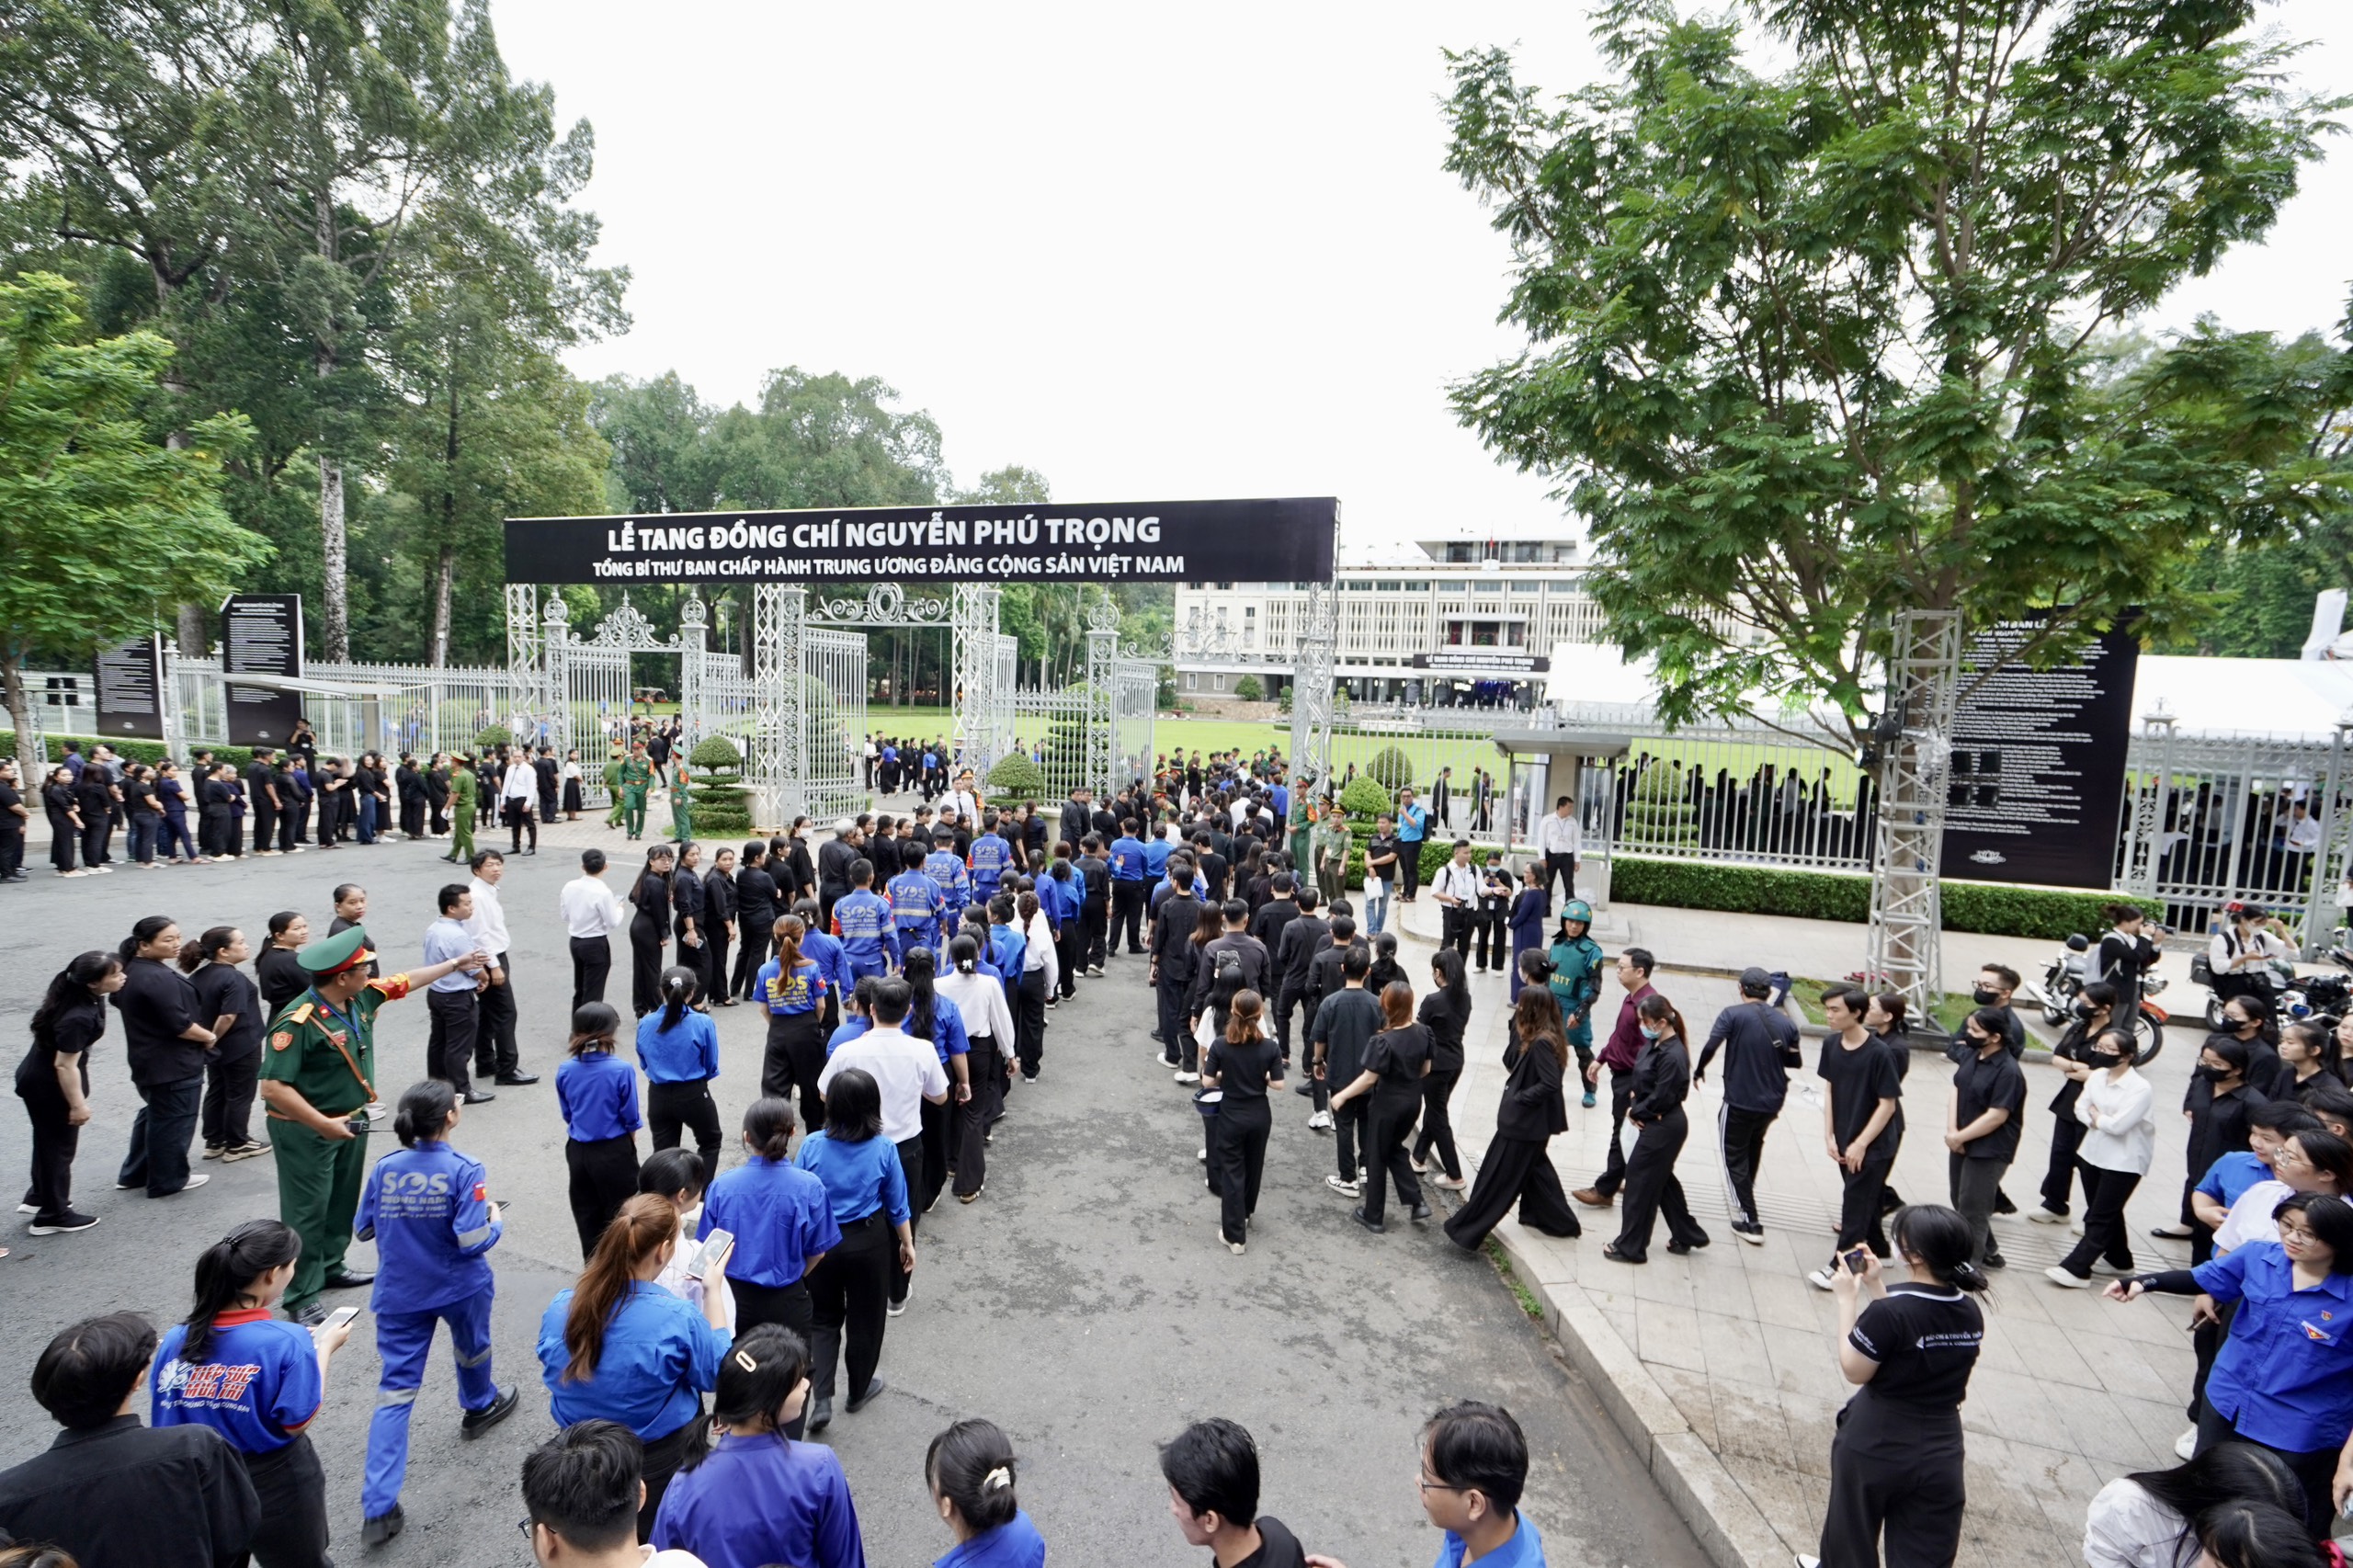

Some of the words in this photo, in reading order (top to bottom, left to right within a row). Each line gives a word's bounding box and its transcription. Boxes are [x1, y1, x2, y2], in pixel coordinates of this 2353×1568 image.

[608, 520, 635, 551] LỄ
[638, 527, 704, 551] TANG
[709, 518, 787, 550] ĐỒNG
[792, 518, 841, 549] CHÍ
[846, 511, 966, 548] NGUYỄN
[973, 513, 1039, 545] PHÚ
[1044, 516, 1161, 551] TRỌNG
[592, 557, 633, 577] TỔNG
[635, 559, 650, 576] BÍ
[651, 559, 684, 576] THƯ
[685, 560, 717, 576] BAN
[719, 555, 761, 575] CHẤP
[764, 556, 811, 574] HÀNH
[813, 558, 871, 574] TRUNG
[874, 556, 926, 574] ƯƠNG
[930, 552, 983, 574] ĐẢNG
[987, 553, 1041, 578] CỘNG
[1045, 551, 1085, 574] SẢN
[1087, 552, 1131, 578] VIỆT
[1136, 556, 1184, 574] NAM
[895, 885, 926, 898] SOS
[841, 905, 877, 919] SOS
[381, 1171, 449, 1196] SOS
[188, 1363, 227, 1382] TIẾP
[222, 1364, 261, 1383] SỨC
[182, 1381, 219, 1399] MÙA
[215, 1382, 247, 1401] THI
